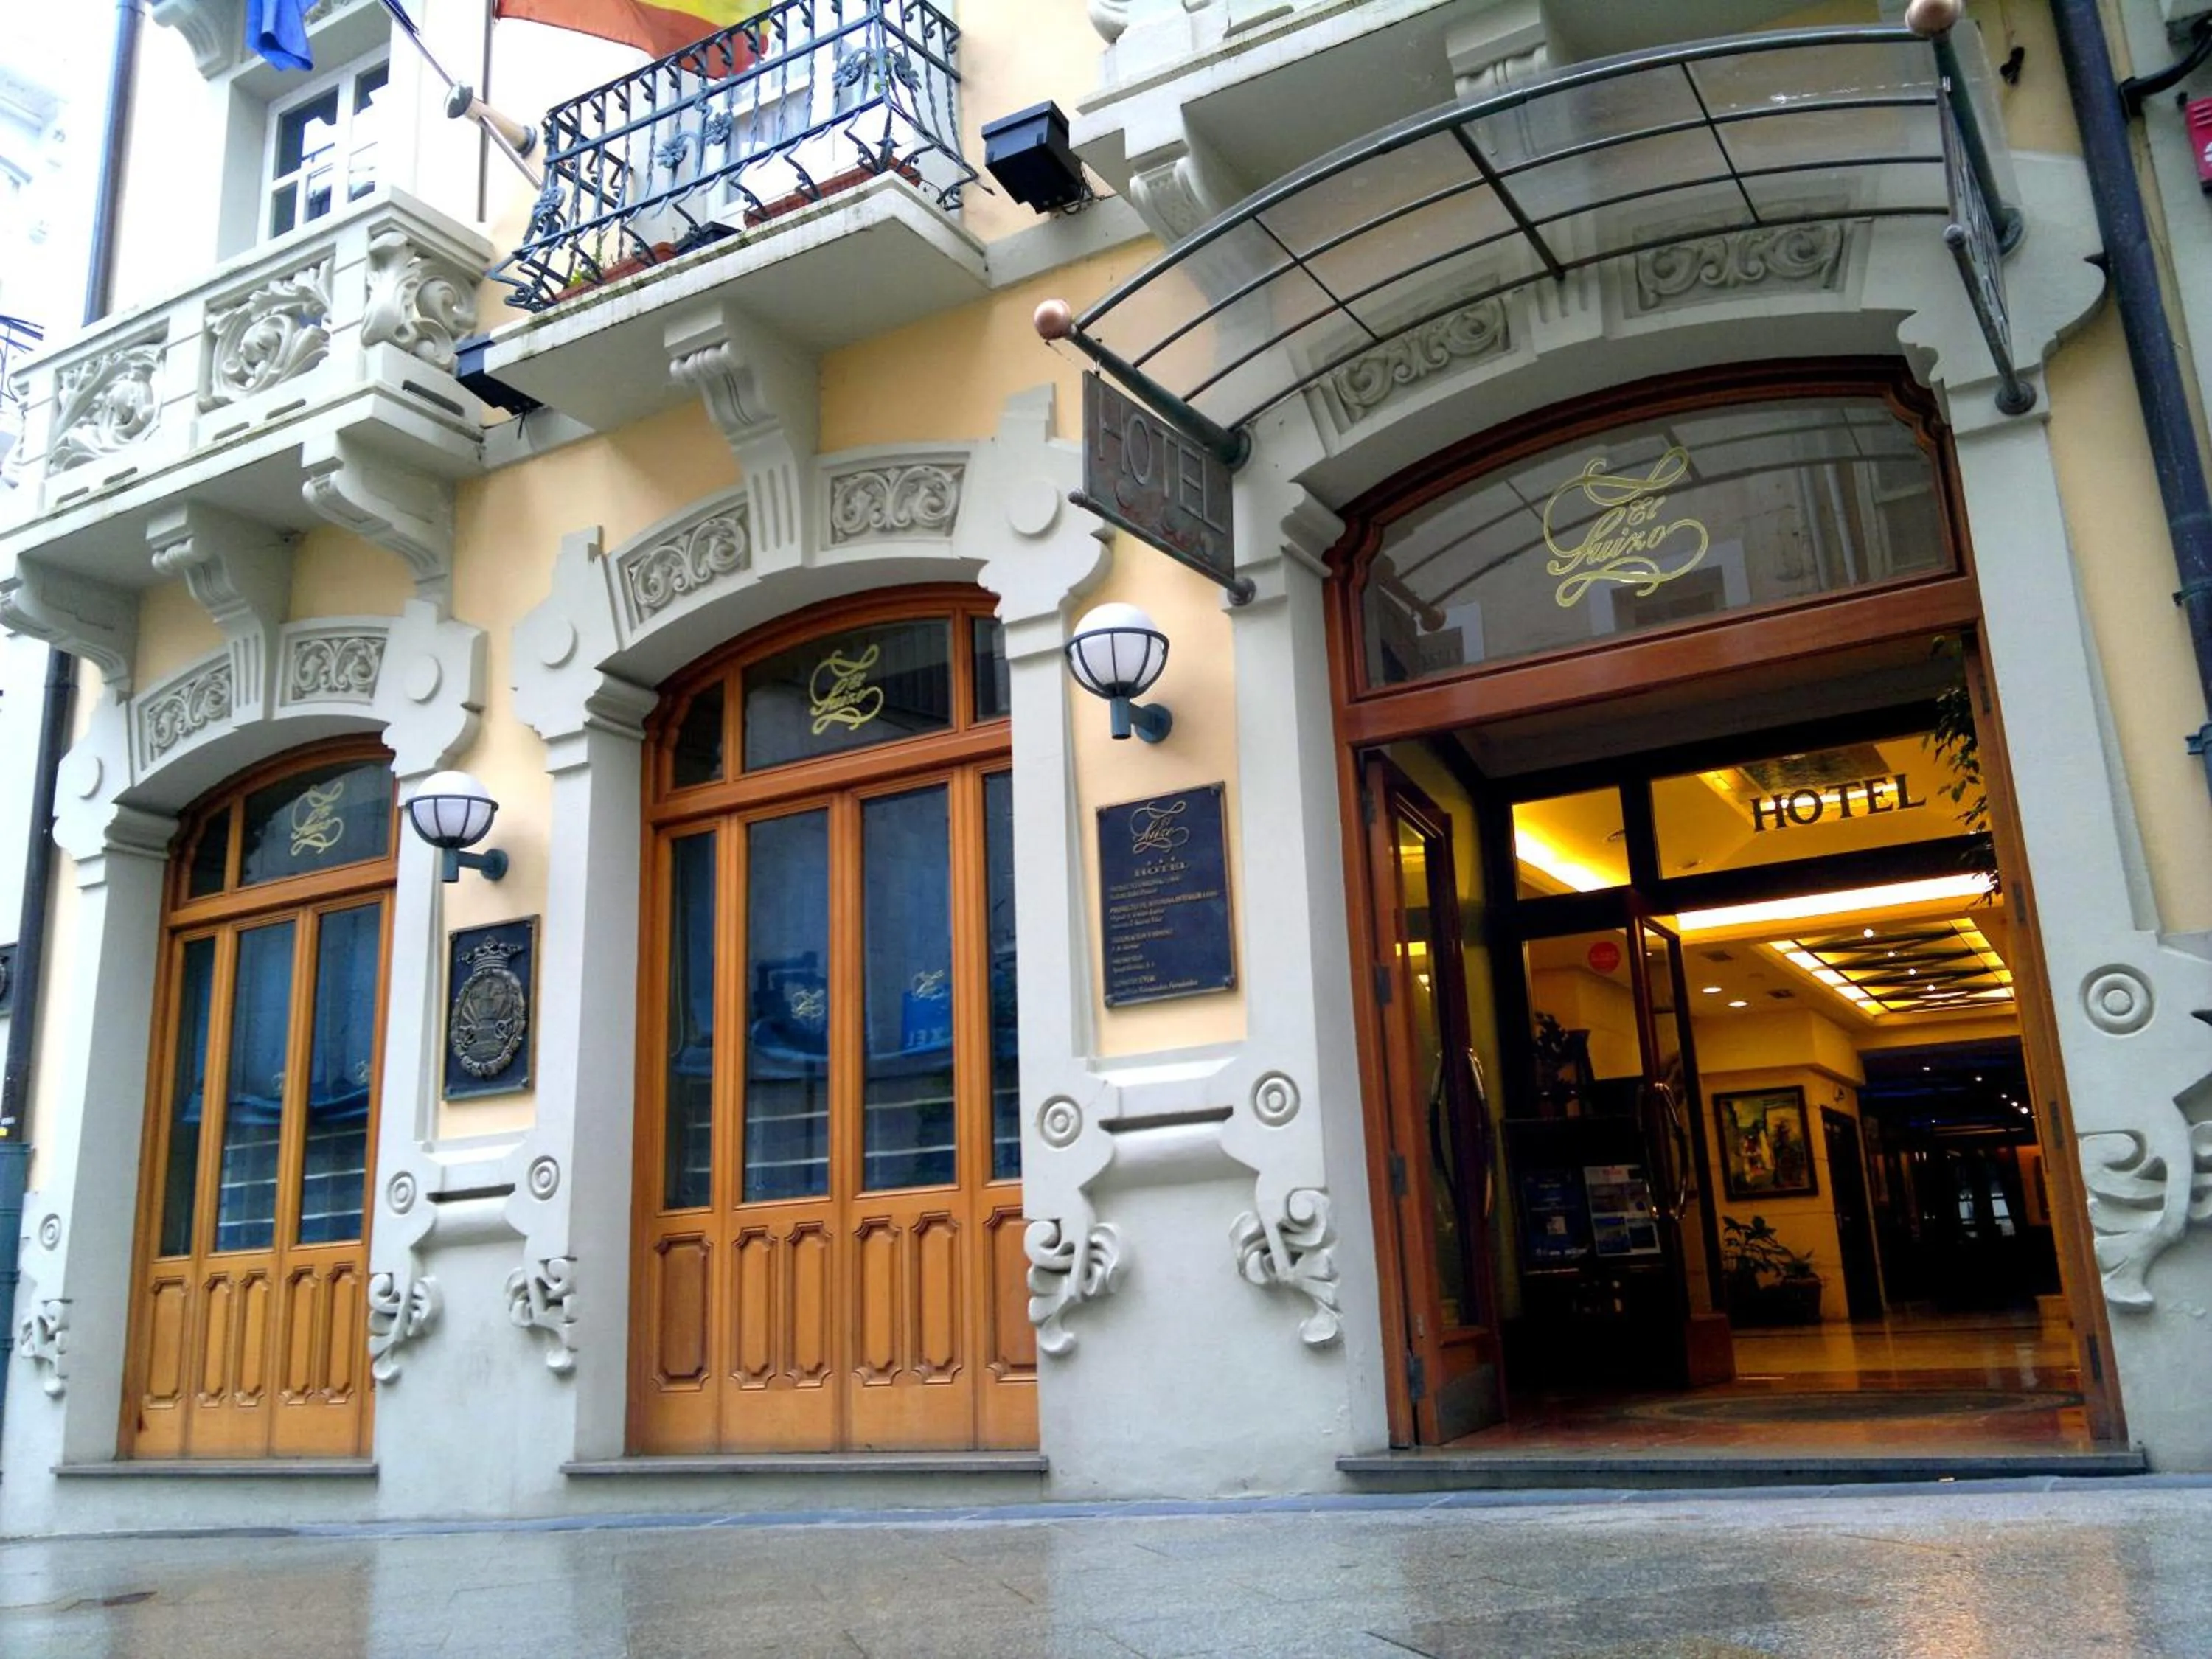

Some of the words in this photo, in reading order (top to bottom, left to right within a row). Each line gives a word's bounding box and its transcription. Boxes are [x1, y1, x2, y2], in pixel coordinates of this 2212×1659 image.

[1098, 388, 1225, 533] HOTEL
[1627, 497, 1666, 526] El
[1750, 774, 1926, 832] HOTEL
